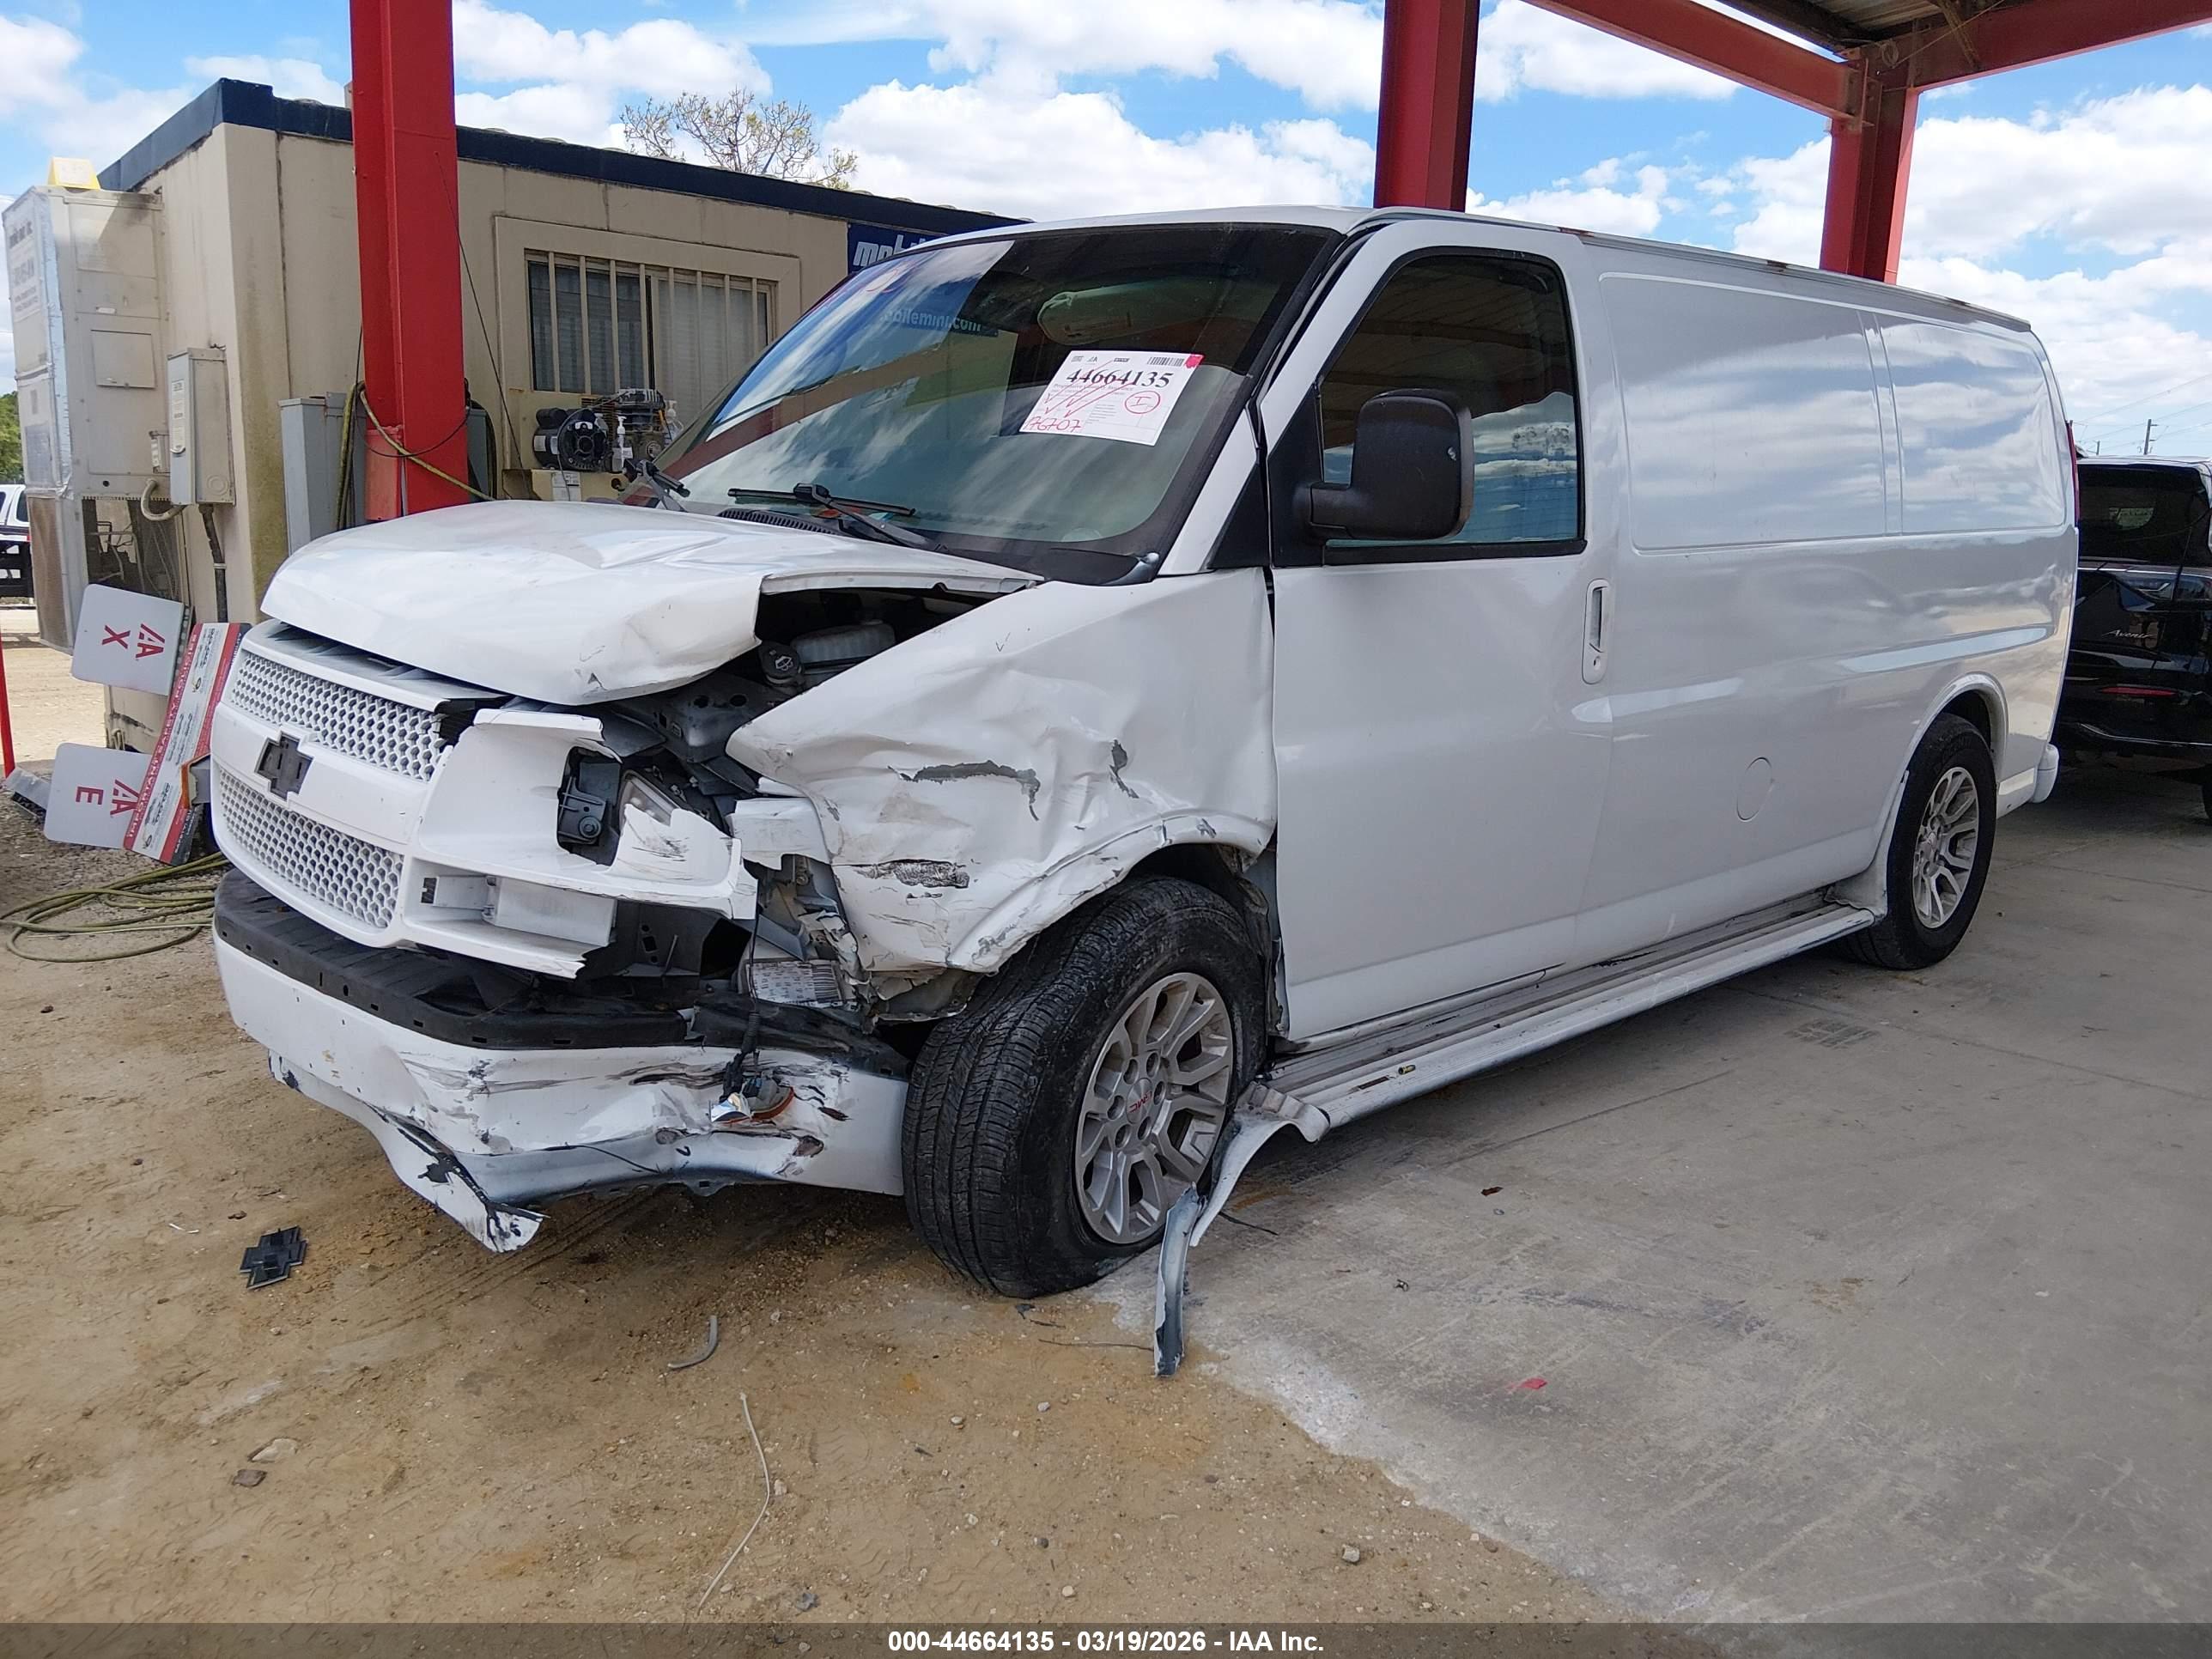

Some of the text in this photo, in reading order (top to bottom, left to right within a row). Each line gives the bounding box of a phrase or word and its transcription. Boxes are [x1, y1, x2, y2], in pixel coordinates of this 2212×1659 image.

[1066, 368, 1174, 389] 44664135
[101, 624, 131, 650] X
[128, 758, 159, 838] IMPORTANT
[158, 703, 177, 754] SAFETY
[75, 786, 104, 805] E
